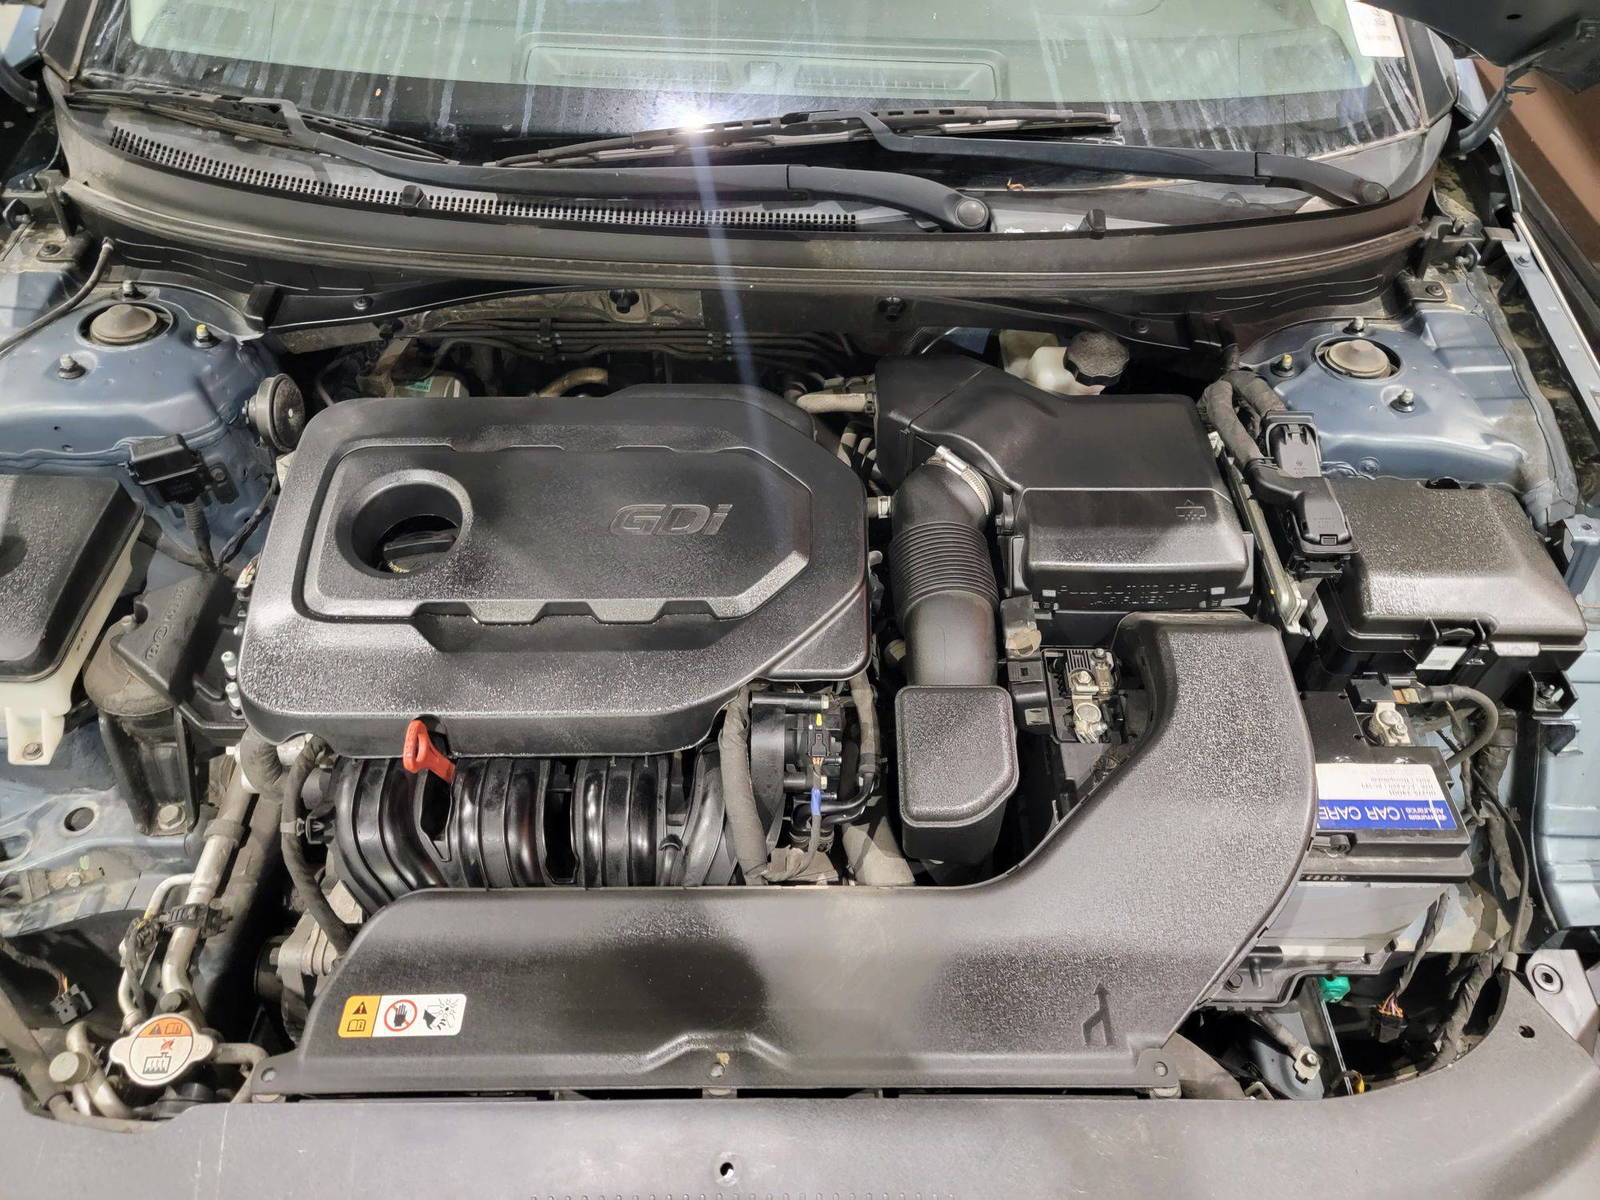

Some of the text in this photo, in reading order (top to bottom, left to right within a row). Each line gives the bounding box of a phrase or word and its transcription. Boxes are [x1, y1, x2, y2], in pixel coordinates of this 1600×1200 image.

[609, 504, 733, 535] GDi
[1319, 806, 1362, 821] CARE
[1367, 806, 1401, 821] CAR
